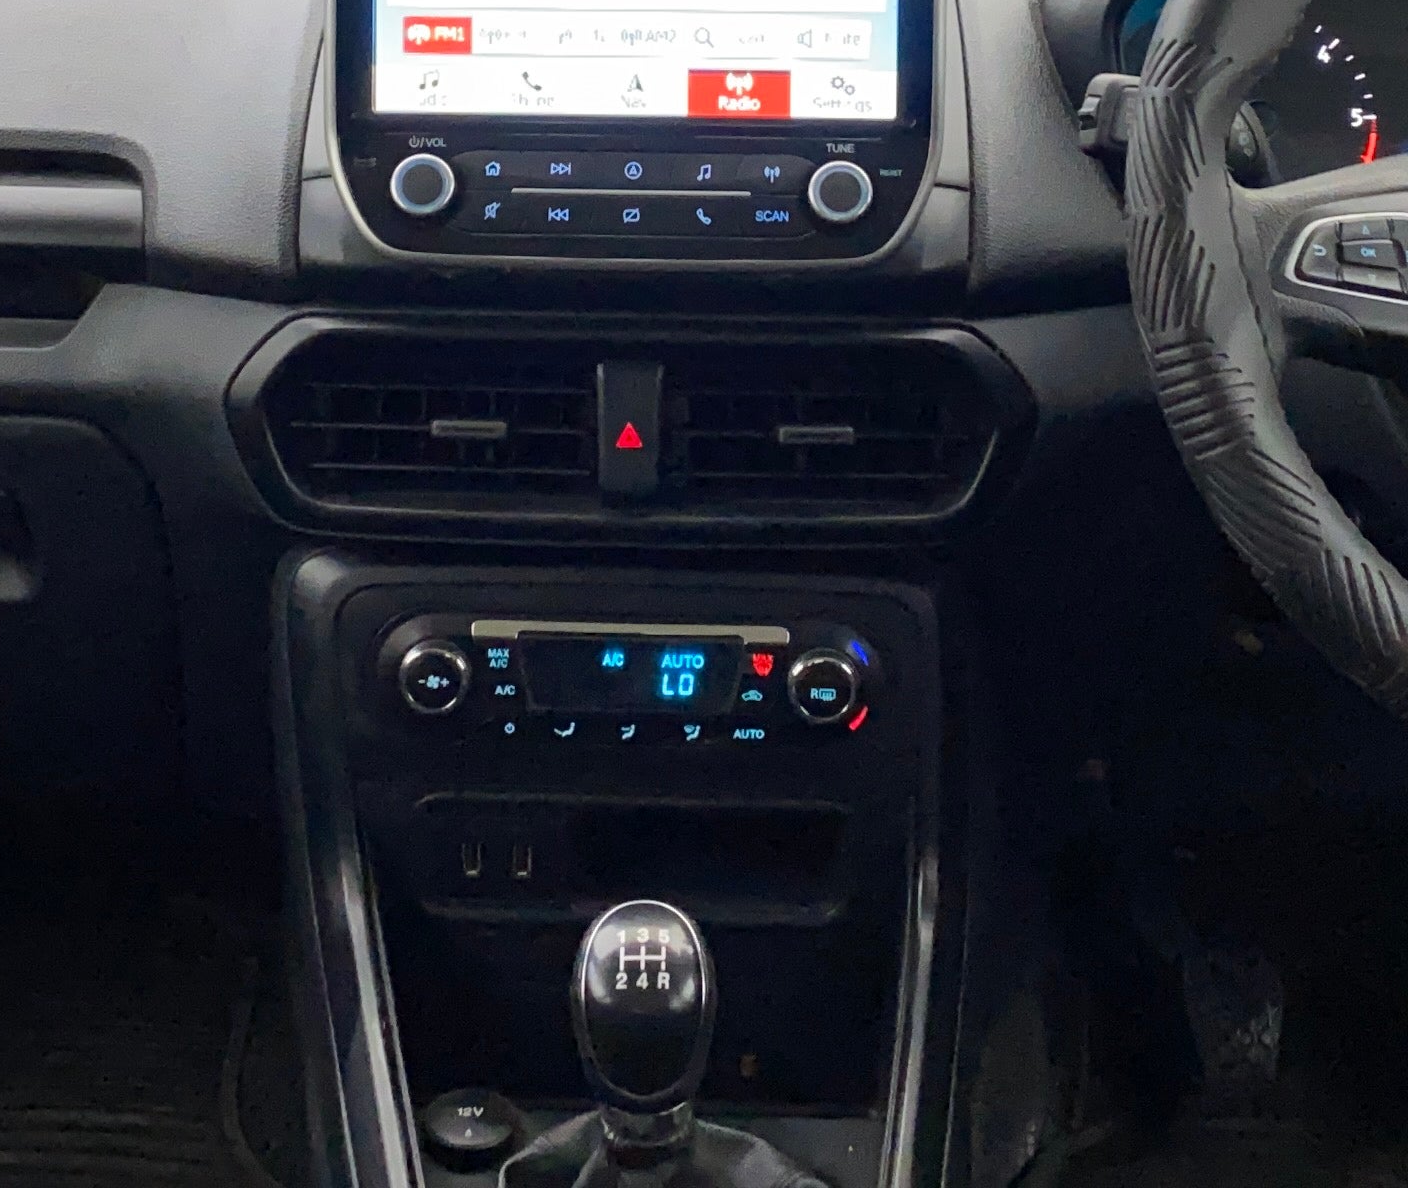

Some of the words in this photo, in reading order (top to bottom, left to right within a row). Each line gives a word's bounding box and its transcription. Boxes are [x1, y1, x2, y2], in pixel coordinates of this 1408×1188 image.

[434, 25, 465, 42] FM1
[1317, 44, 1331, 63] 4
[718, 95, 761, 111] Radio
[1351, 108, 1363, 127] 5
[826, 143, 855, 154] TUNE
[755, 211, 789, 223] SCAN
[1360, 247, 1376, 258] OK
[487, 648, 510, 658] MAX
[601, 653, 624, 667] A/C
[489, 658, 508, 668] A/C
[661, 653, 705, 669] AUTO
[494, 685, 516, 695] A/C
[661, 673, 694, 696] LO
[733, 728, 765, 740] AUTO
[616, 929, 626, 944] 1
[636, 928, 650, 943] 3
[658, 929, 670, 944] 5
[615, 972, 628, 990] 2
[635, 972, 649, 990] 4
[657, 972, 670, 990] R
[457, 1106, 484, 1117] 12V
